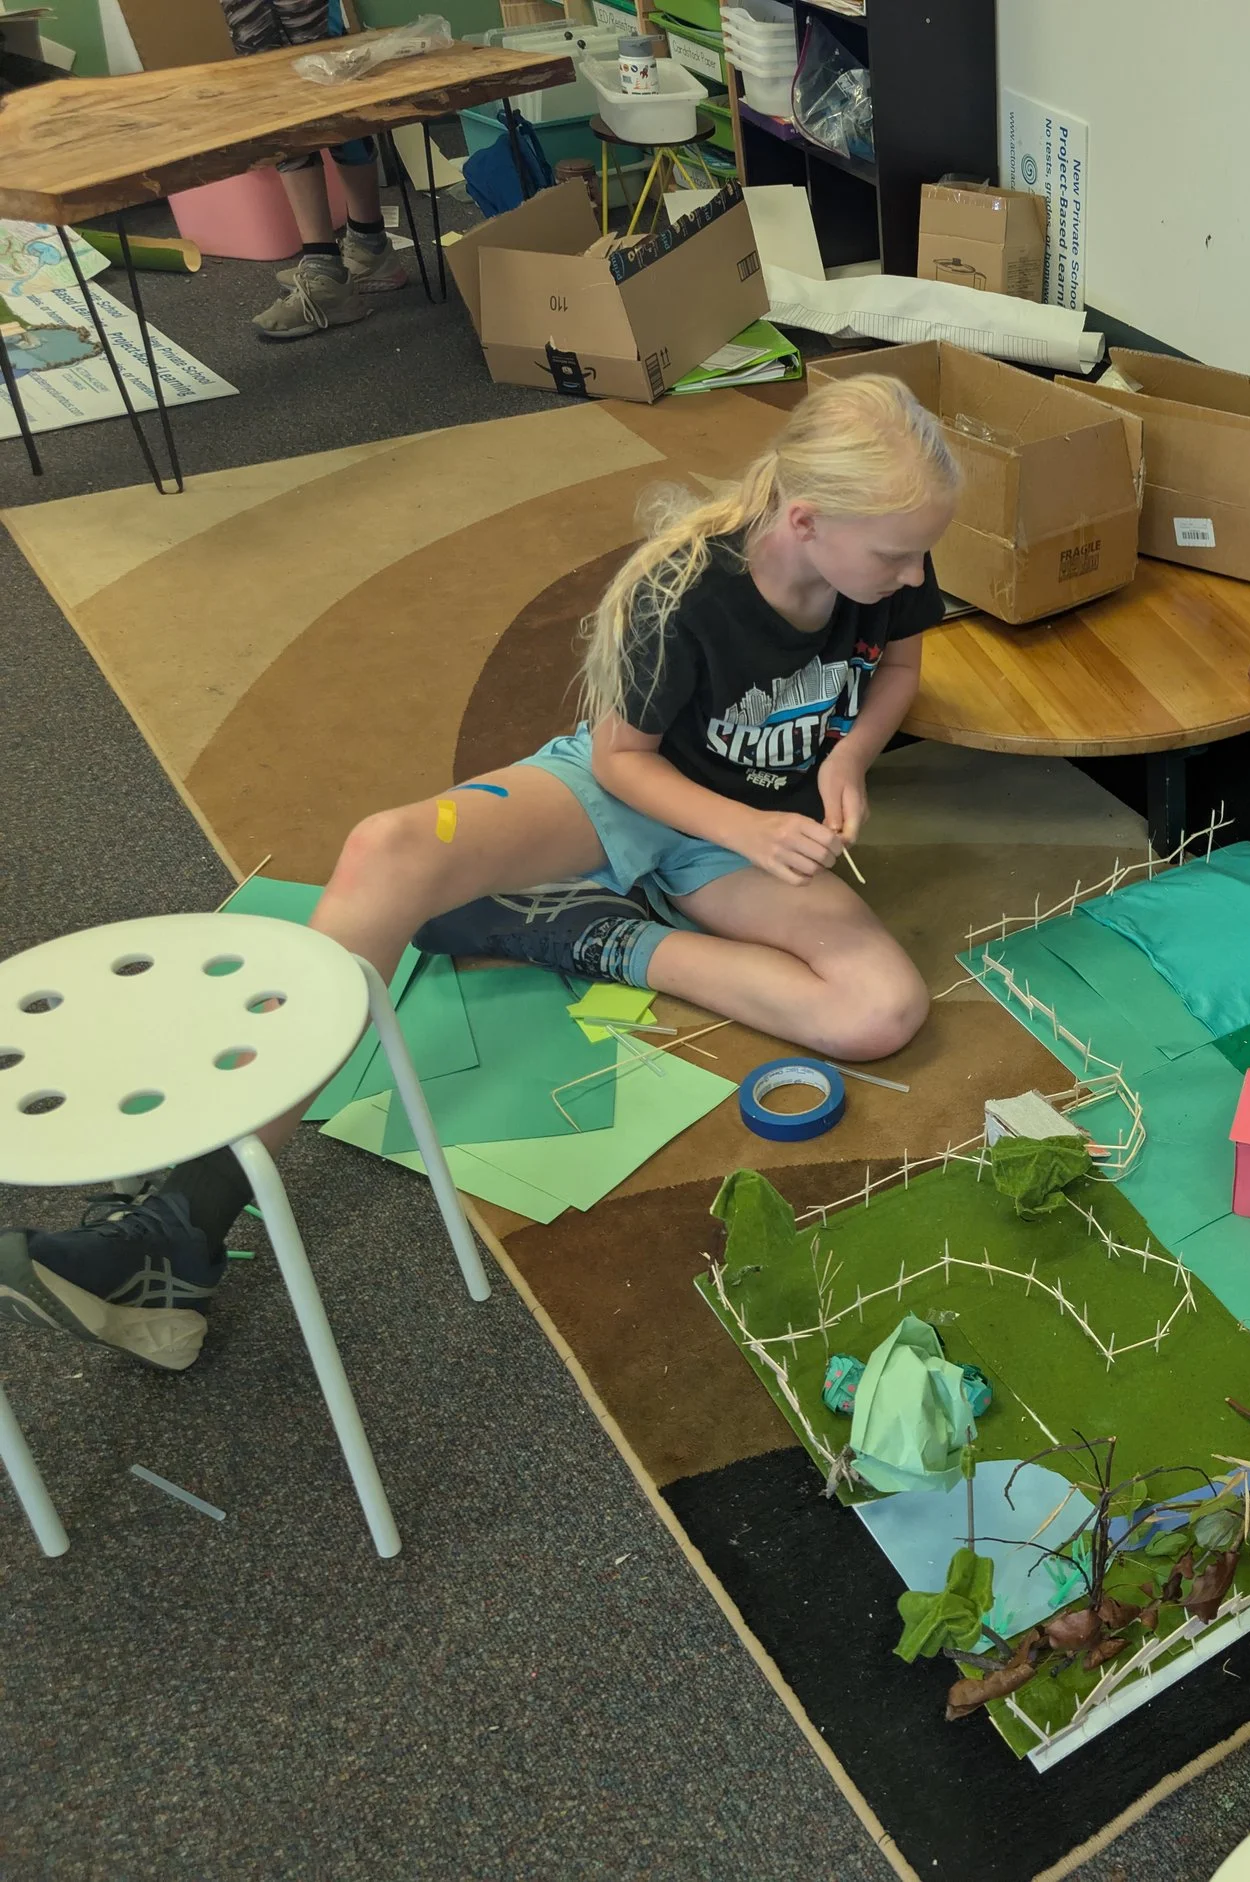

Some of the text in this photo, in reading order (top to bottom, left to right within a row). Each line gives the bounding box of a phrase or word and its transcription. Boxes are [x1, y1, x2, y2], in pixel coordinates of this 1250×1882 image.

[1045, 118, 1052, 138] No
[1057, 126, 1069, 308] Project-Based Learni
[1069, 159, 1081, 310] New Private Schoo
[184, 361, 216, 386] School
[1060, 539, 1102, 562] FRAGILE
[706, 706, 837, 768] SCIOT
[745, 768, 779, 782] FLEET
[746, 773, 774, 788] FEET
